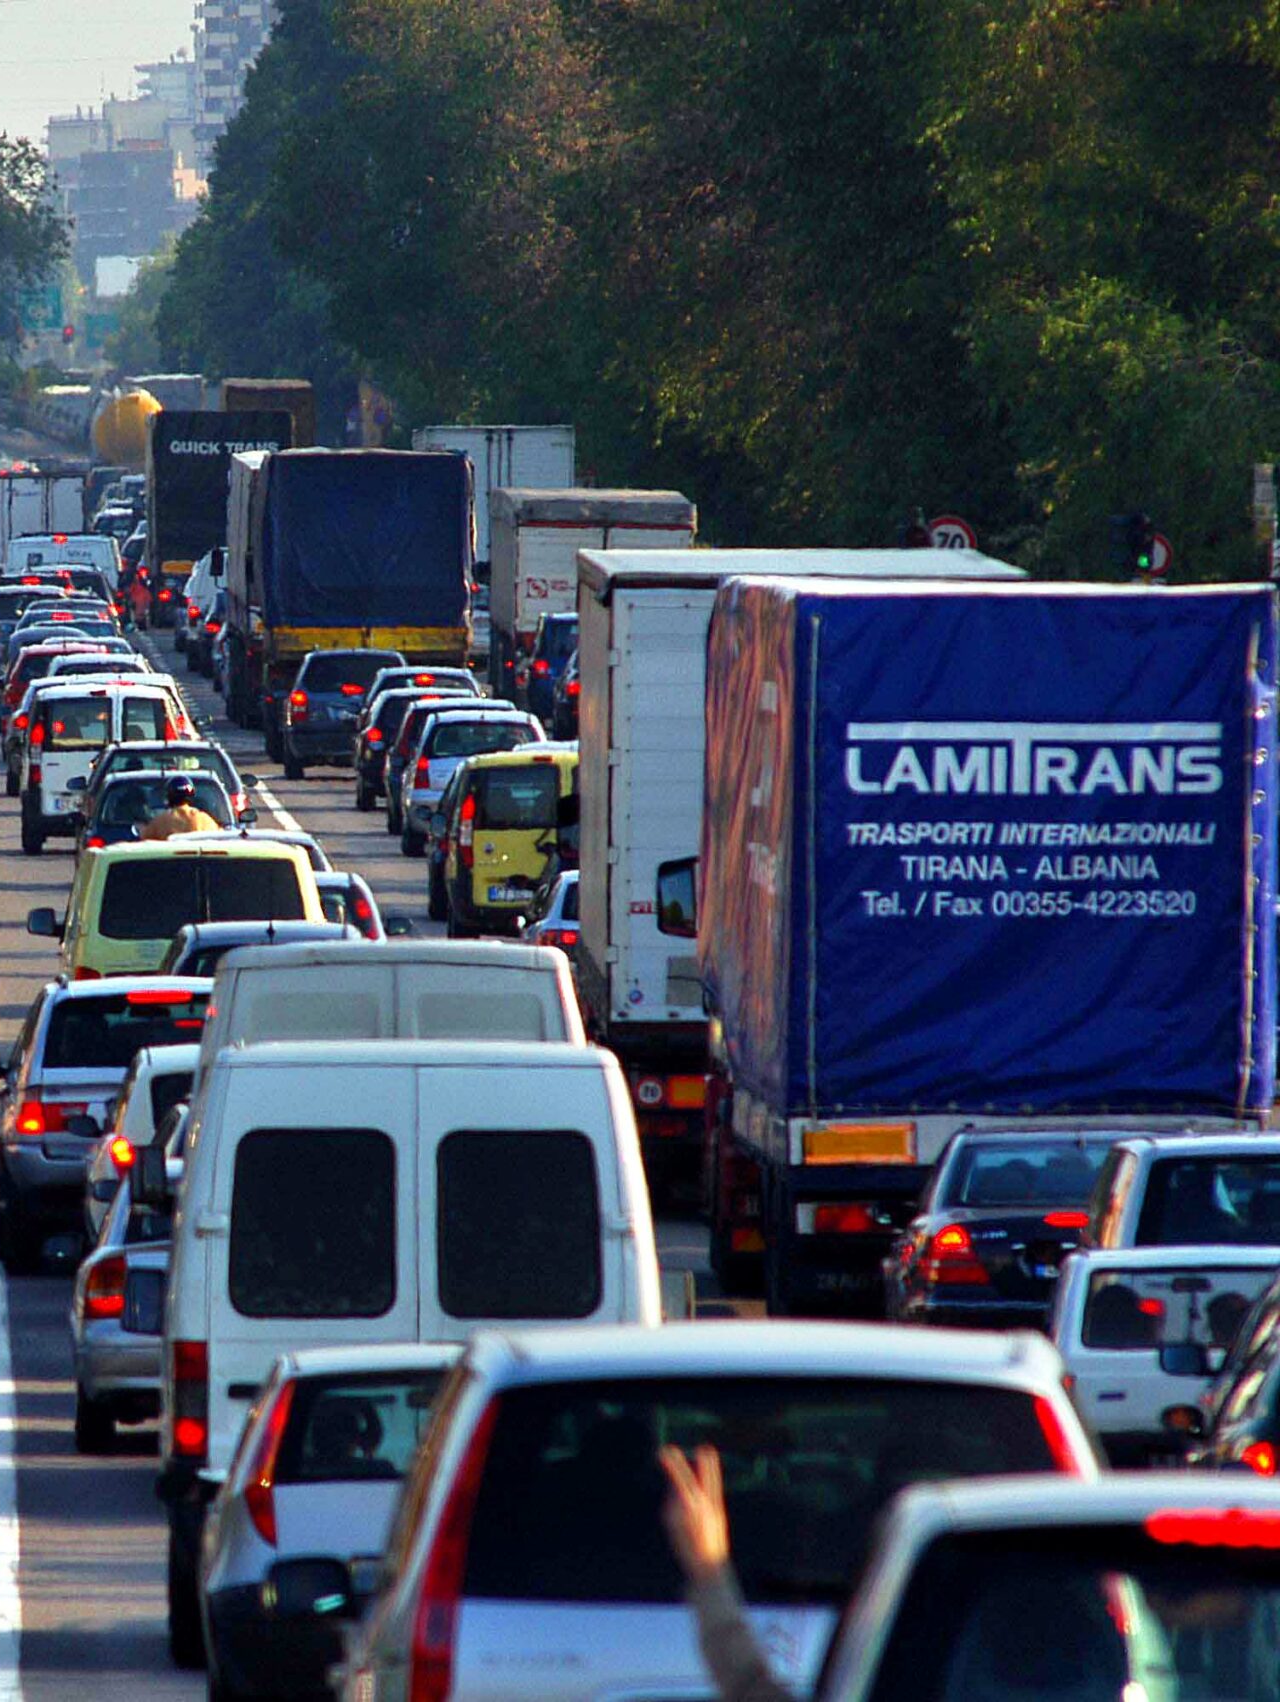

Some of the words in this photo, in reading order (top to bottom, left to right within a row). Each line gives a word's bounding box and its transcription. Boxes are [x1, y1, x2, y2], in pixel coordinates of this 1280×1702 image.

[170, 440, 220, 455] QUICK
[937, 532, 965, 548] 70
[846, 722, 1222, 795] LAMITRANS
[847, 822, 994, 845] TRASPORTI
[1000, 822, 1216, 845] INTERNAZIONALI
[900, 855, 1009, 880] TIRANA
[1034, 855, 1160, 880] ALBANIA
[861, 890, 907, 916] Tel.
[934, 891, 983, 916] Fax
[992, 890, 1197, 916] 00355-4223520
